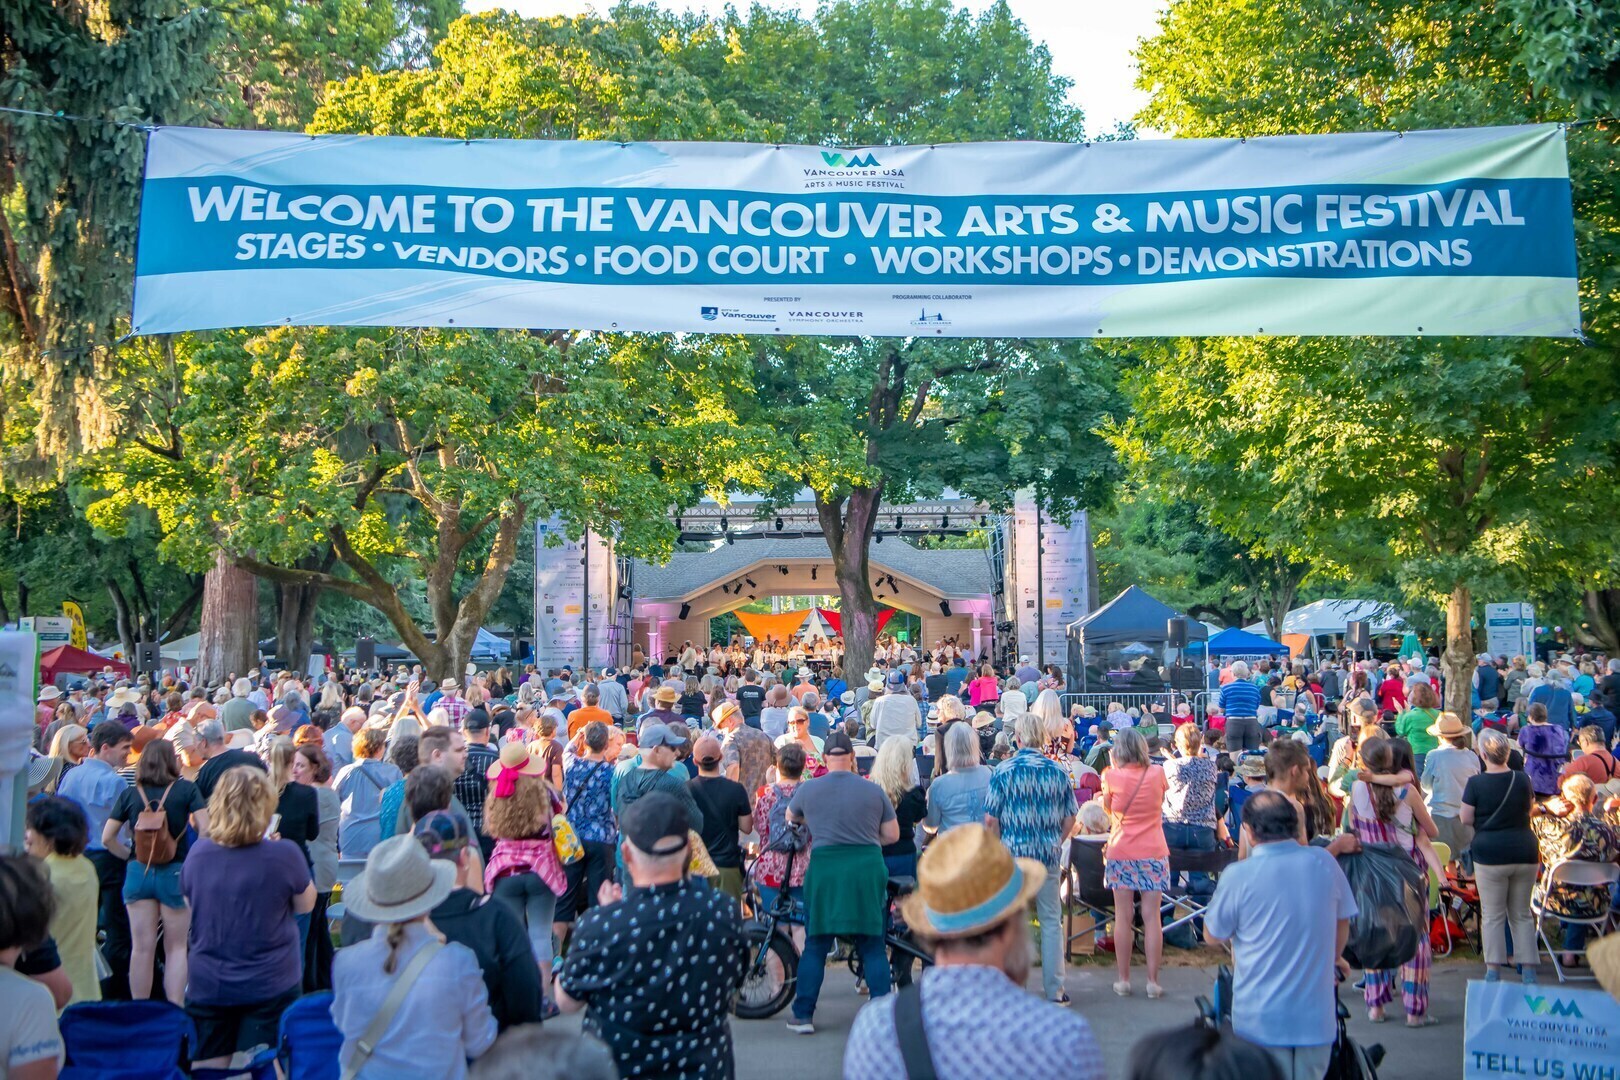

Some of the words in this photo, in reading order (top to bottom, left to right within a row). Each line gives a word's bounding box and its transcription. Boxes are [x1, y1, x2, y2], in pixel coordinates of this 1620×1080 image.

[803, 169, 877, 177] VANCOUVER
[883, 169, 905, 177] USA
[866, 181, 905, 189] FESTIVAL
[188, 185, 435, 233] WELCOME
[447, 195, 514, 233] TO
[527, 196, 613, 232] THE
[626, 197, 946, 239] VANCOUVER
[957, 204, 1079, 237] ARTS
[1091, 203, 1134, 234] &
[1146, 194, 1303, 234] MUSIC
[1316, 189, 1525, 232] FESTIVAL
[235, 232, 366, 260] STAGES
[392, 241, 568, 275] VENDORS
[594, 244, 698, 275] FOOD
[707, 244, 830, 275] COURT
[870, 245, 1112, 275] WORKSHOPS
[1138, 238, 1472, 275] DEMONSTRATIONS
[1507, 1018, 1579, 1034] VANCOUVER
[1585, 1026, 1608, 1037] USA
[1538, 1035, 1566, 1045] MUSIC
[1569, 1039, 1607, 1049] FESTIVAL
[1472, 1051, 1526, 1075] TELL
[1534, 1057, 1565, 1079] US
[1572, 1062, 1620, 1080] WH
